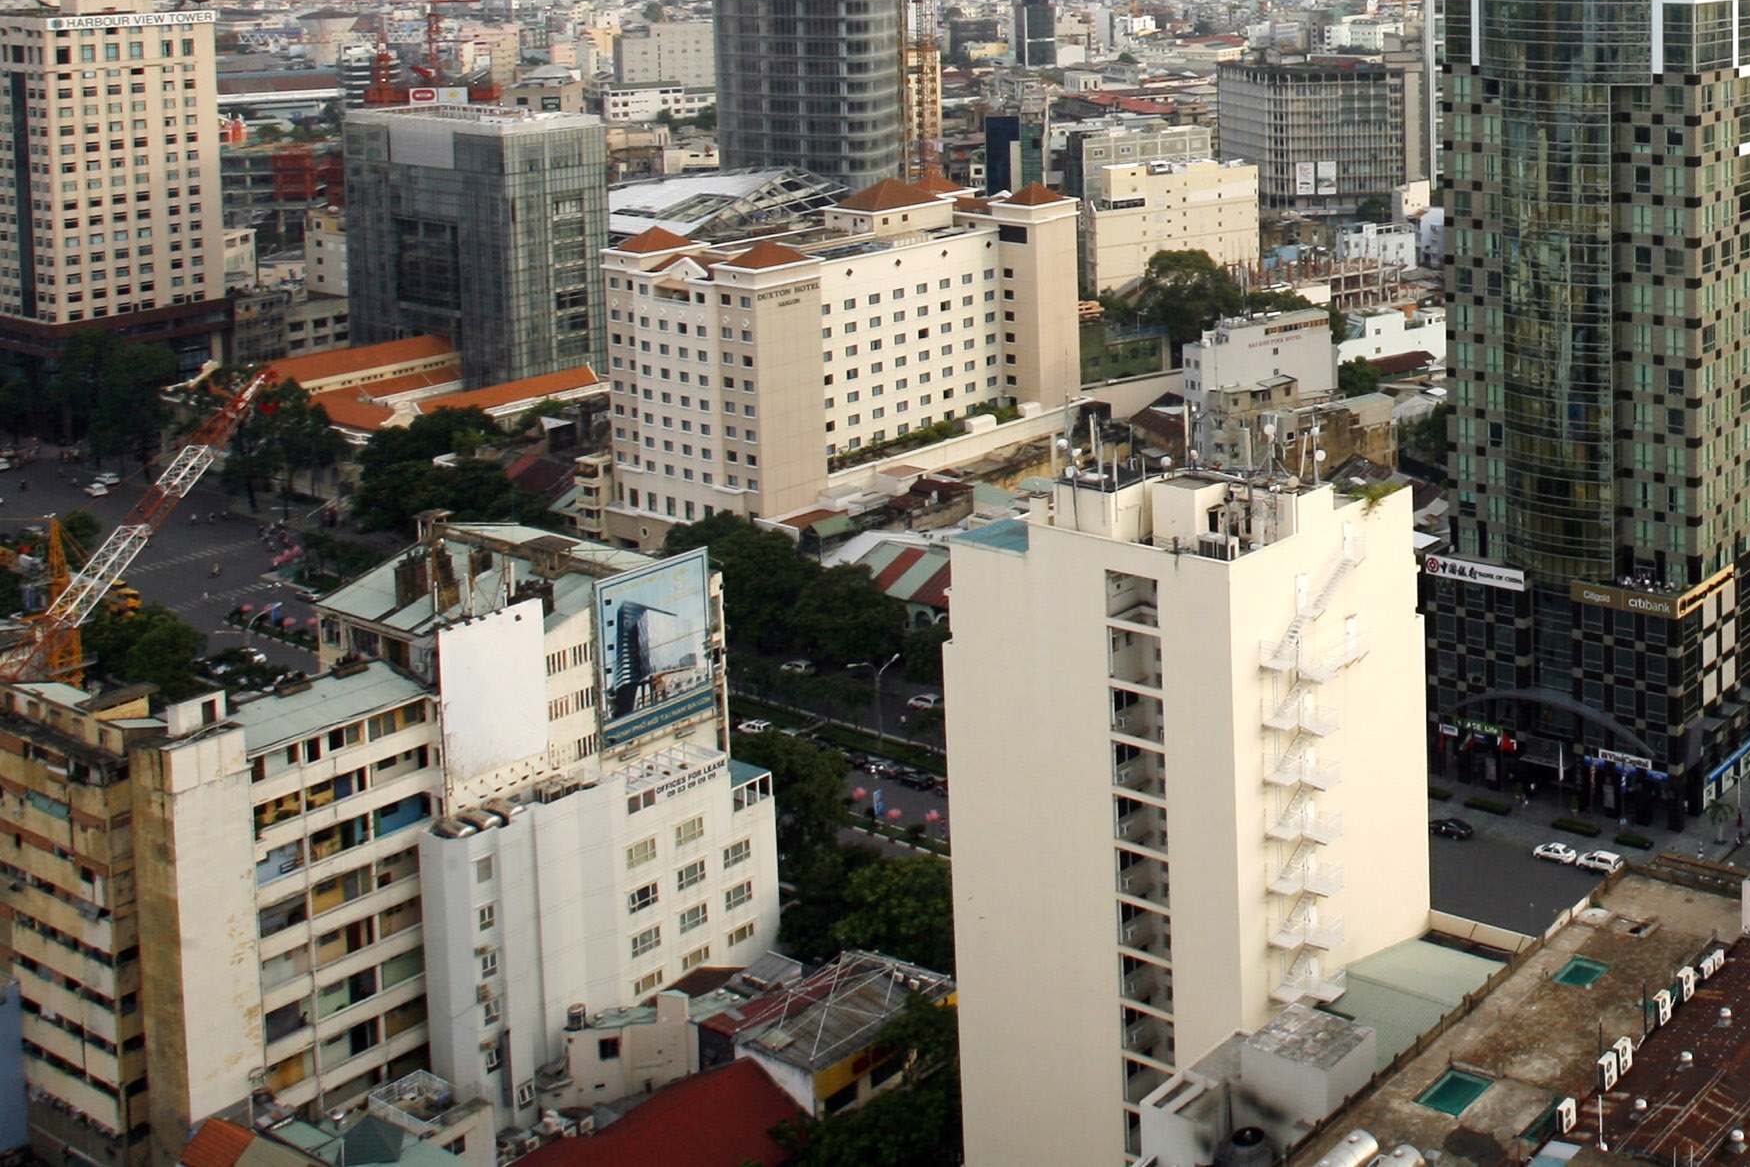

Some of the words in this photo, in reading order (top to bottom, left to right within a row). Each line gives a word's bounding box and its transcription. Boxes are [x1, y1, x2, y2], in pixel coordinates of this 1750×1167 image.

[66, 16, 130, 28] HARBOUR
[133, 14, 166, 25] VIEW
[169, 12, 213, 24] TOWER
[1628, 597, 1671, 614] citibank
[688, 769, 702, 781] FOR
[703, 759, 725, 774] LEASE
